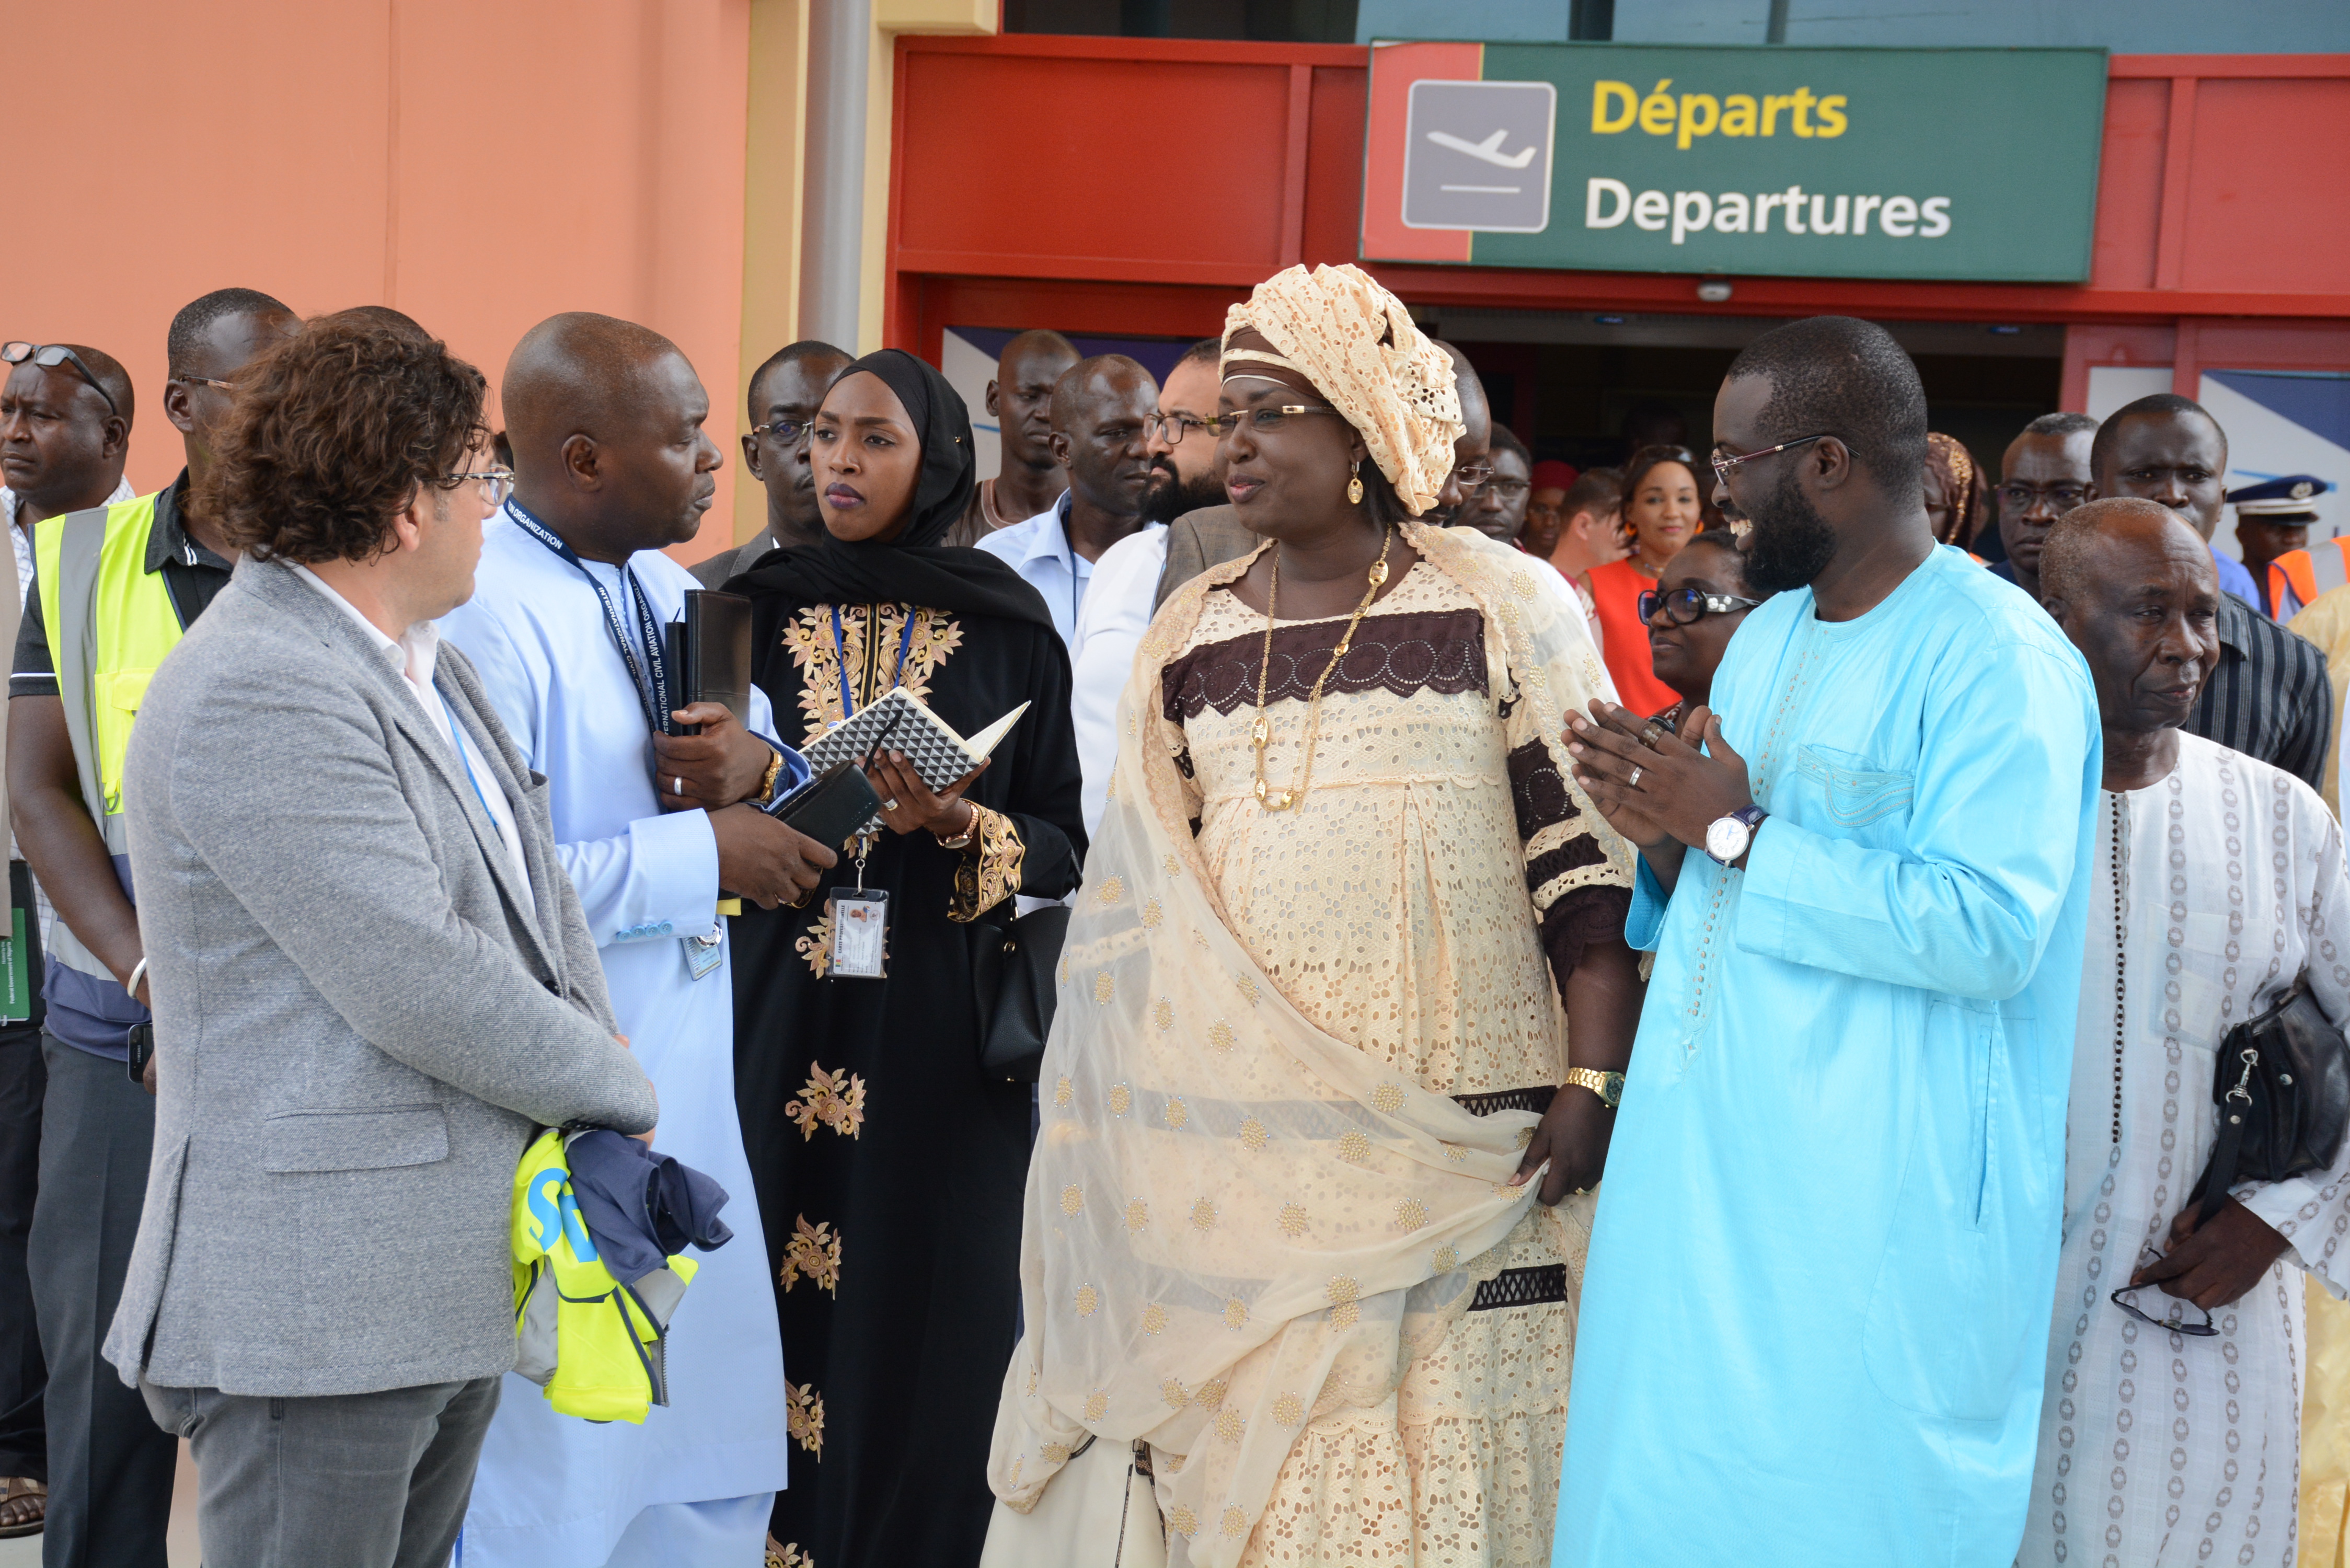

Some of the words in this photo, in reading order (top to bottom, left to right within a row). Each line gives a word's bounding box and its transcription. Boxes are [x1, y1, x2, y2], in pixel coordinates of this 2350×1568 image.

[1591, 78, 1848, 150] Départs
[1585, 177, 1951, 245] Departures
[513, 509, 562, 549] ORGANIZATION
[598, 587, 628, 654] INTERNATIONAL
[627, 655, 637, 677] CIVIL
[644, 621, 660, 656] AVIATION
[653, 658, 663, 678] CIVIL
[656, 679, 669, 735] TERNATIONAL
